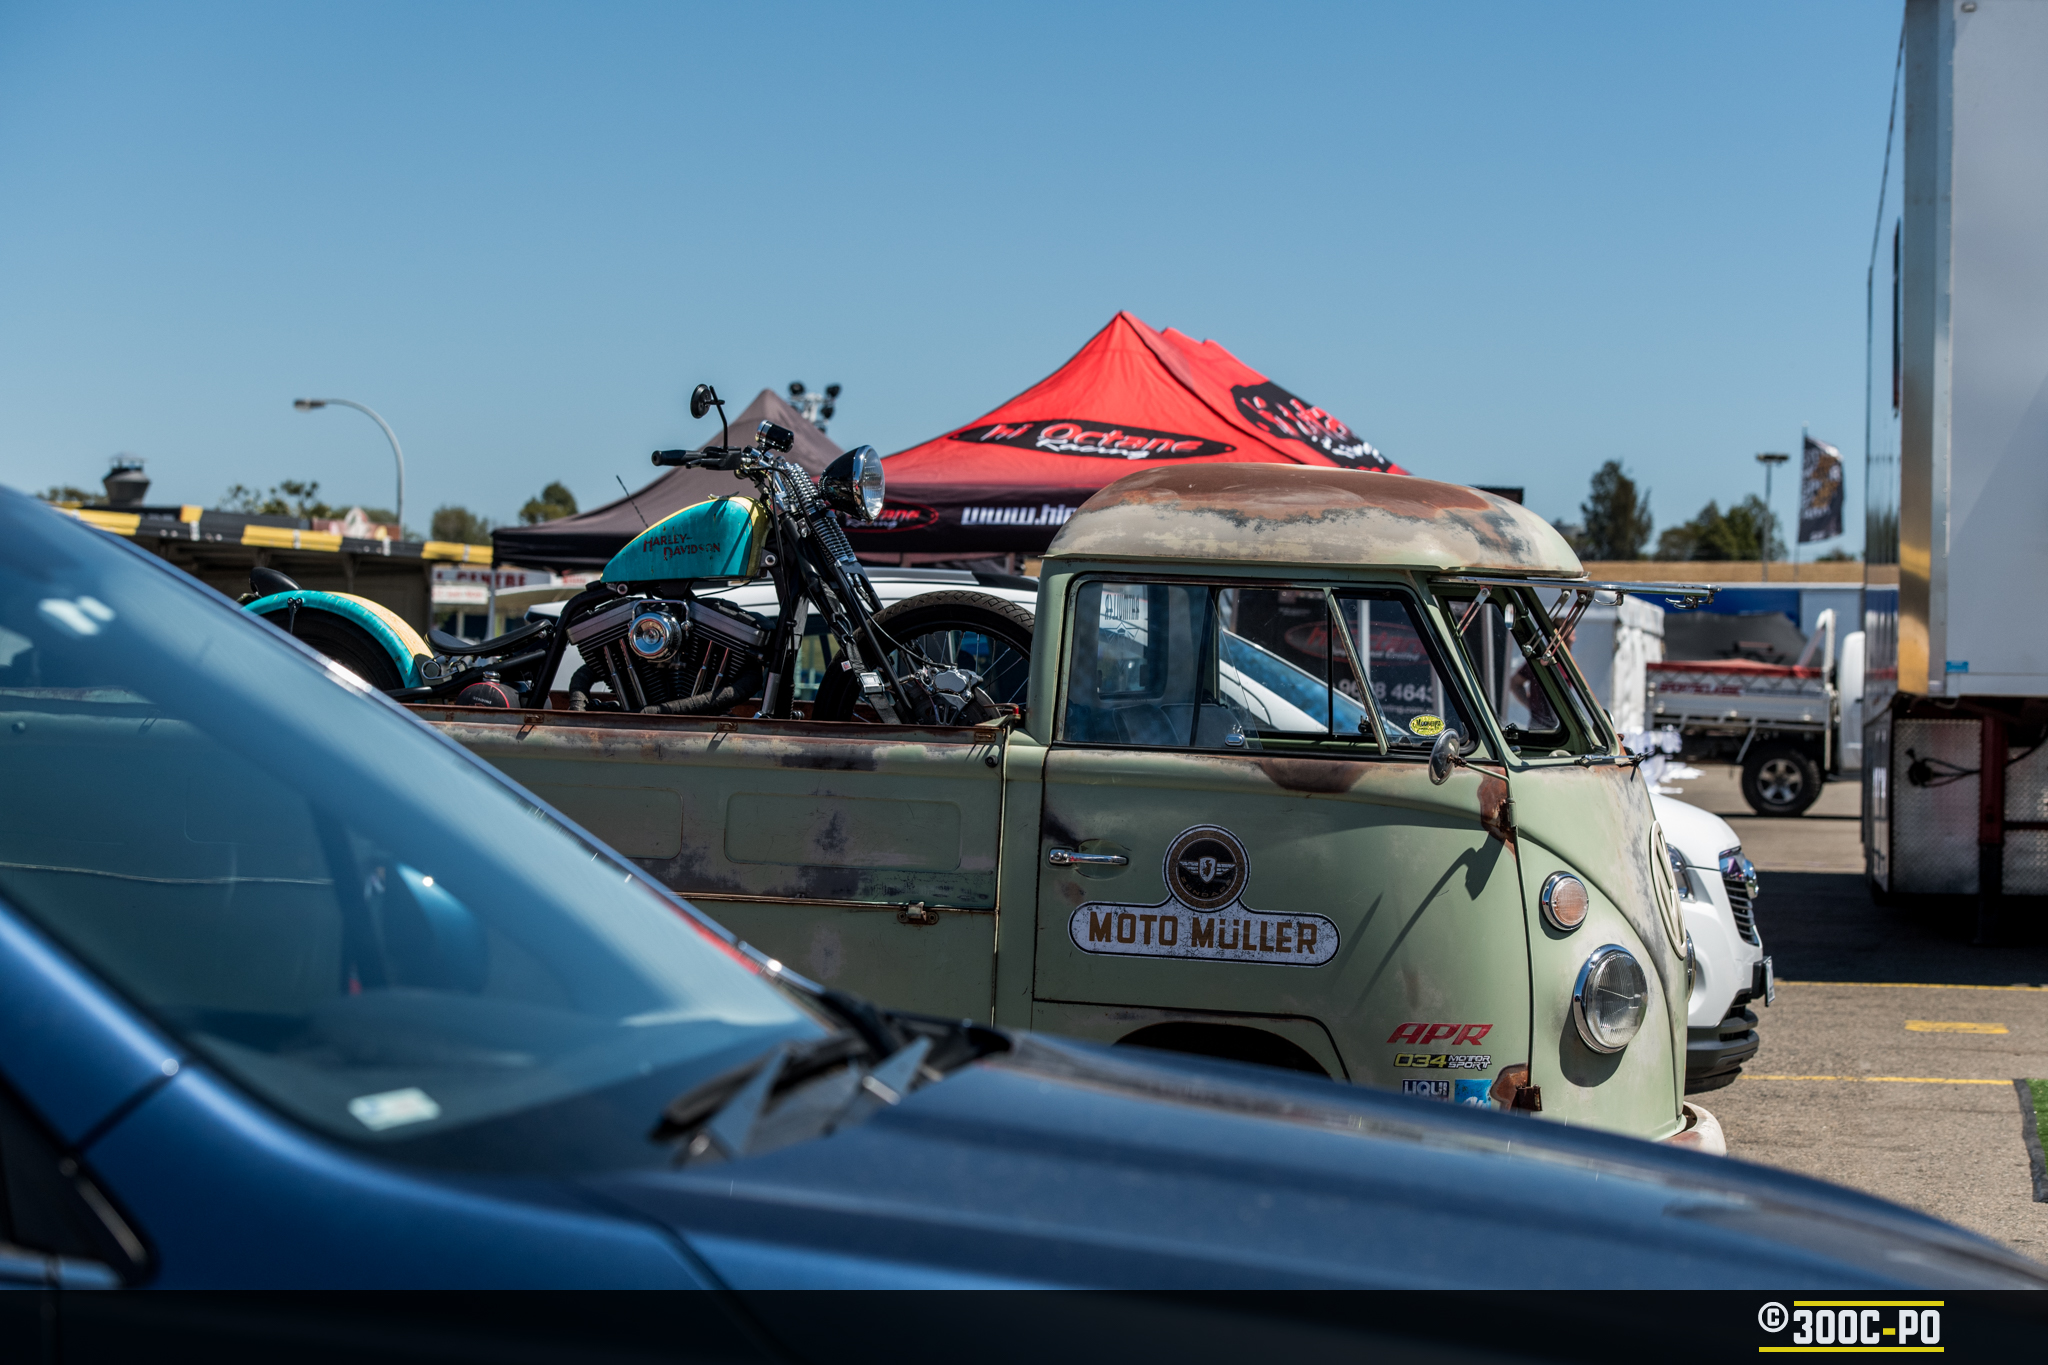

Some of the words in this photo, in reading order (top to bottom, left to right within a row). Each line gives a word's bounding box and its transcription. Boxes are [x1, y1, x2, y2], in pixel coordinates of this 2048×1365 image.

[1040, 422, 1204, 454] Octane
[1338, 678, 1387, 699] 968
[1088, 911, 1178, 946] MOTO
[1190, 917, 1318, 955] MÜLLER
[1386, 1022, 1494, 1046] APR
[1394, 1053, 1447, 1068] 034
[1447, 1061, 1491, 1071] SPORT
[1404, 1080, 1448, 1097] LIQUI
